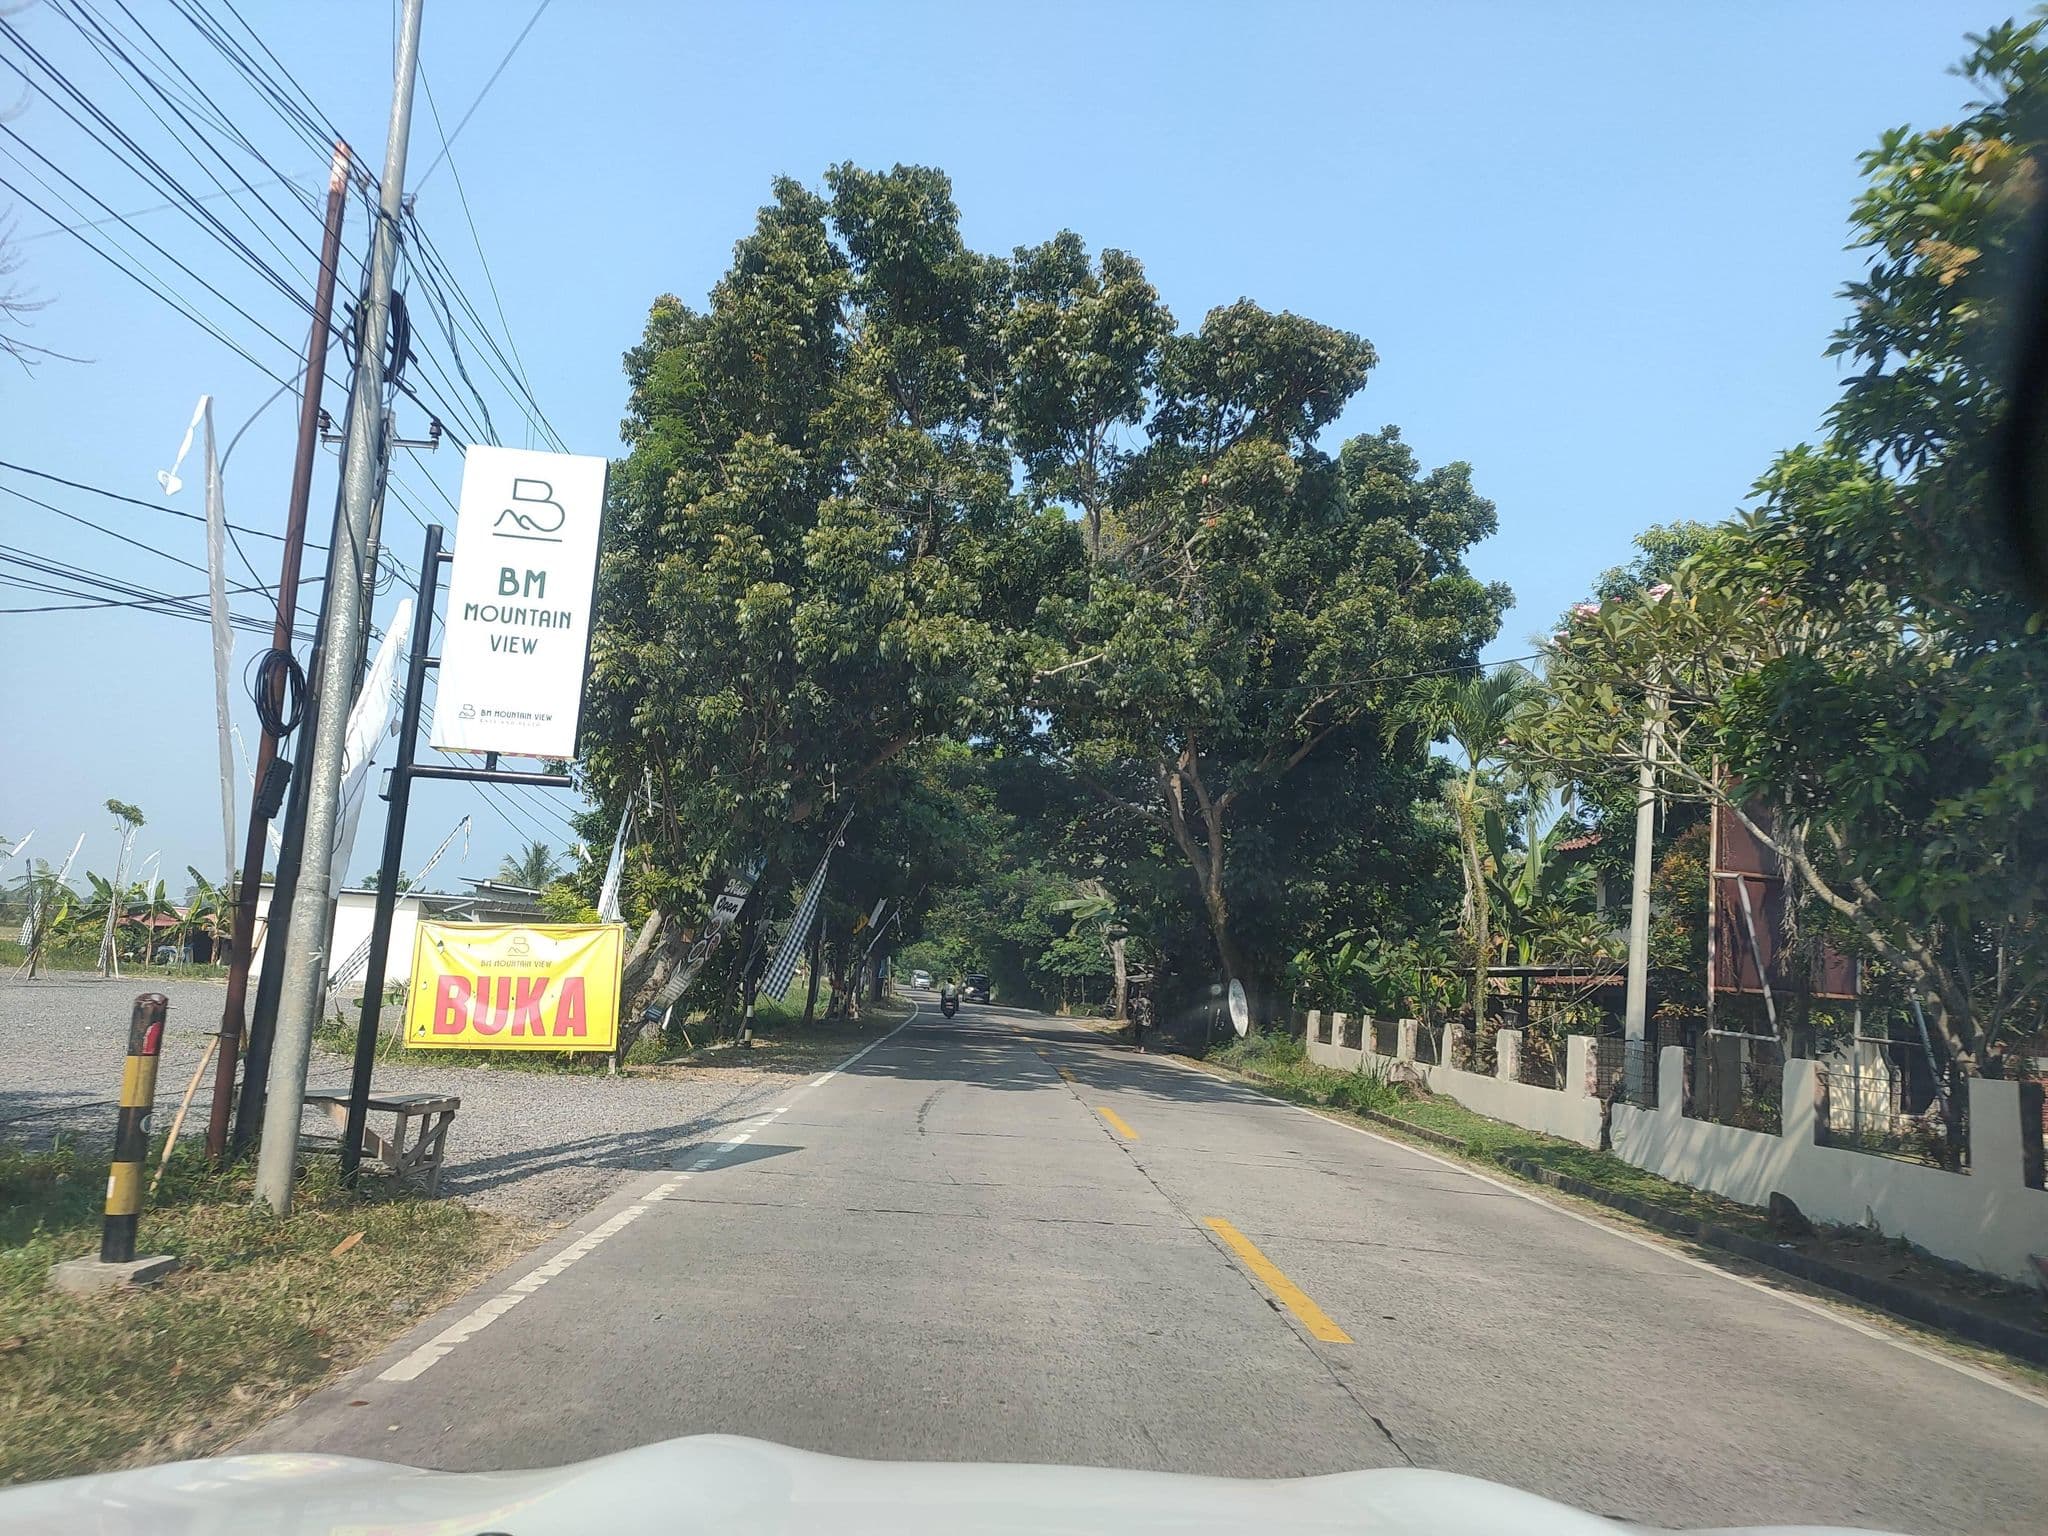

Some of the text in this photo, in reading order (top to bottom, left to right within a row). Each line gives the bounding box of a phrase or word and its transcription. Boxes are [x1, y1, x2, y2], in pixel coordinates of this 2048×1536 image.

[498, 567, 547, 599] BM
[464, 602, 572, 629] MOUNTAIN
[490, 634, 538, 655] VIEW
[480, 709, 553, 721] BM MOUNTAIN VIEW
[716, 896, 739, 914] Open
[433, 975, 587, 1037] BUKA
